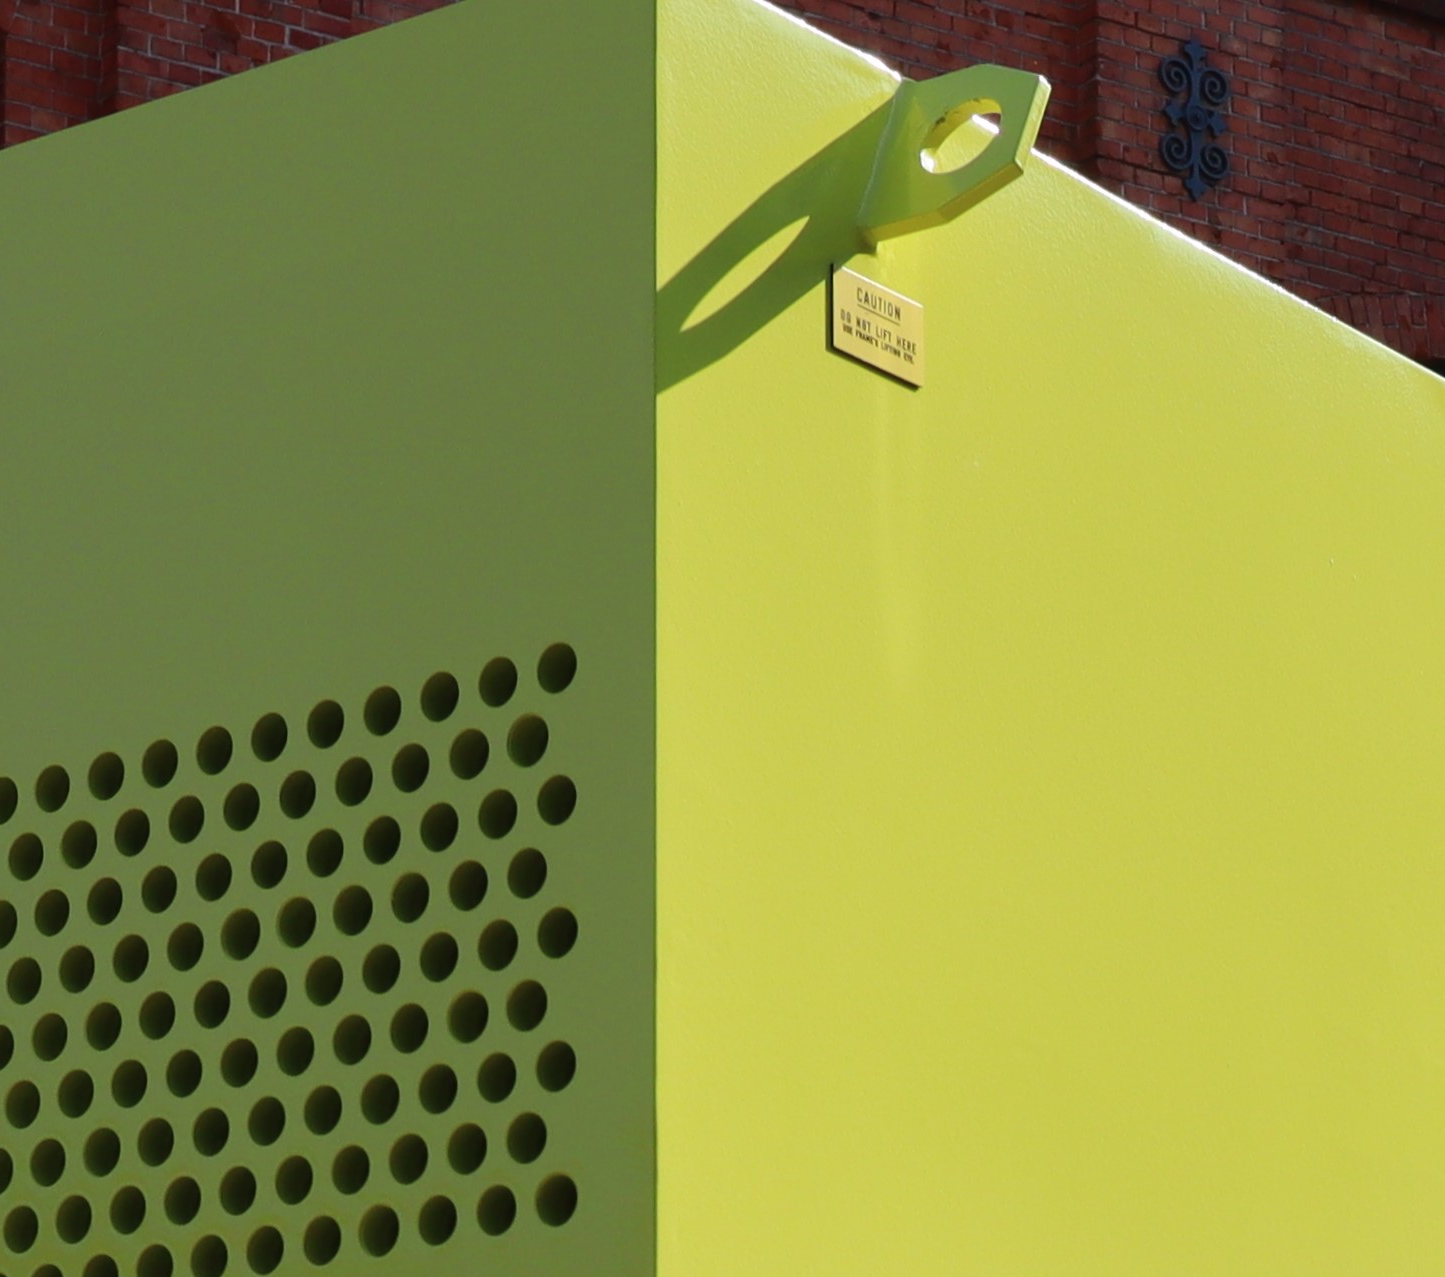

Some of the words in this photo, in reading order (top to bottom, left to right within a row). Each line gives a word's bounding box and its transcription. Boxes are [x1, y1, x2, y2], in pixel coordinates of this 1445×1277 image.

[856, 287, 901, 321] CAUTION
[840, 308, 851, 324] DO
[856, 316, 871, 332] NOT
[875, 326, 892, 342] LIFT
[896, 336, 916, 355] HERE
